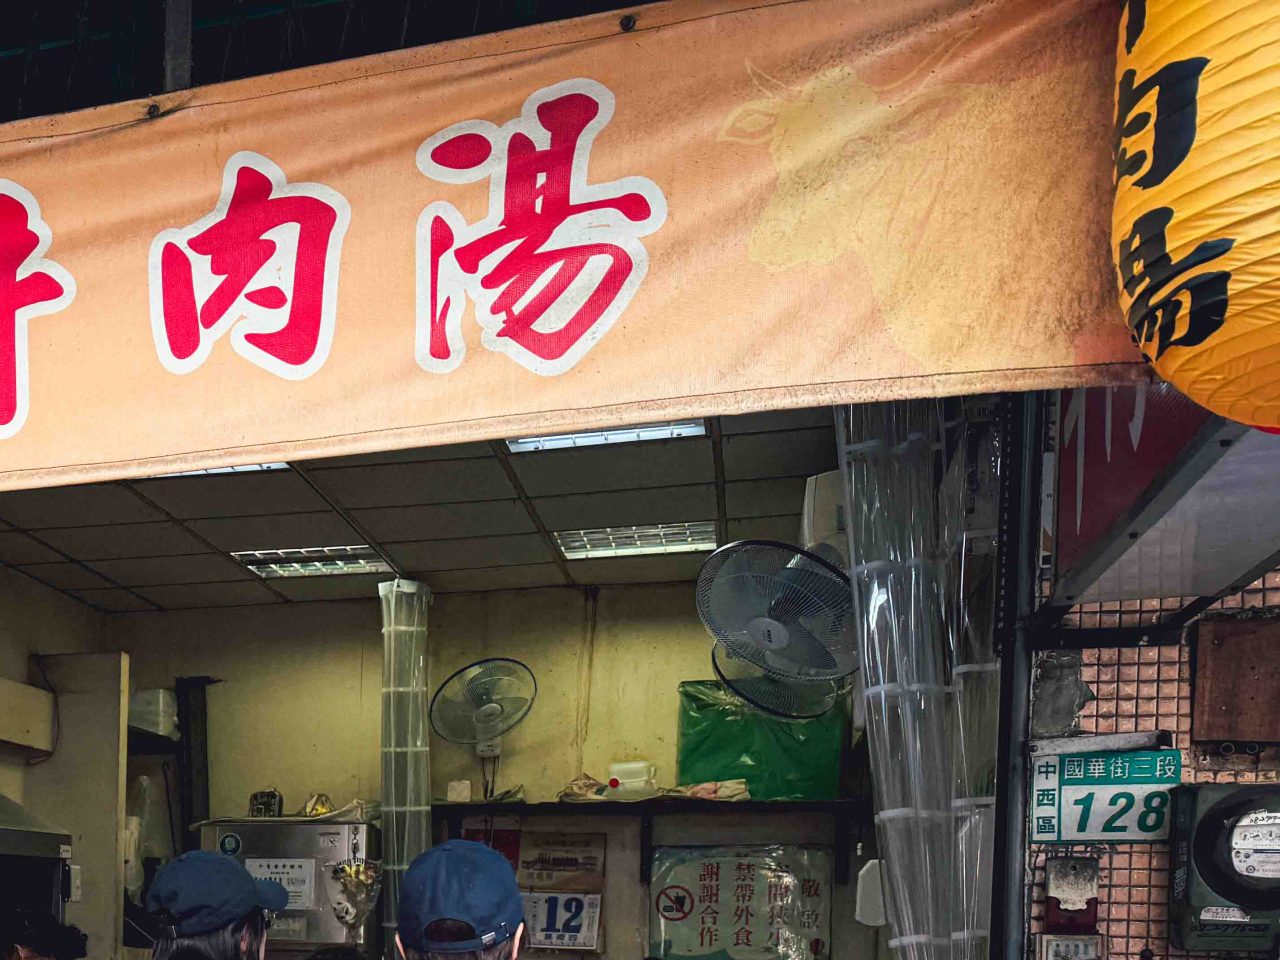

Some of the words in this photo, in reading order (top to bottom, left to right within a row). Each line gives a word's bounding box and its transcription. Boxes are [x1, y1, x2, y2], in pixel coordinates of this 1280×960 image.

[1064, 755, 1177, 780] 國華街三段
[1035, 760, 1057, 835] 中西區
[1072, 790, 1170, 834] 128
[541, 895, 584, 933] 12
[698, 862, 720, 947] 謝謝合作
[733, 862, 757, 947] 禁帶外食
